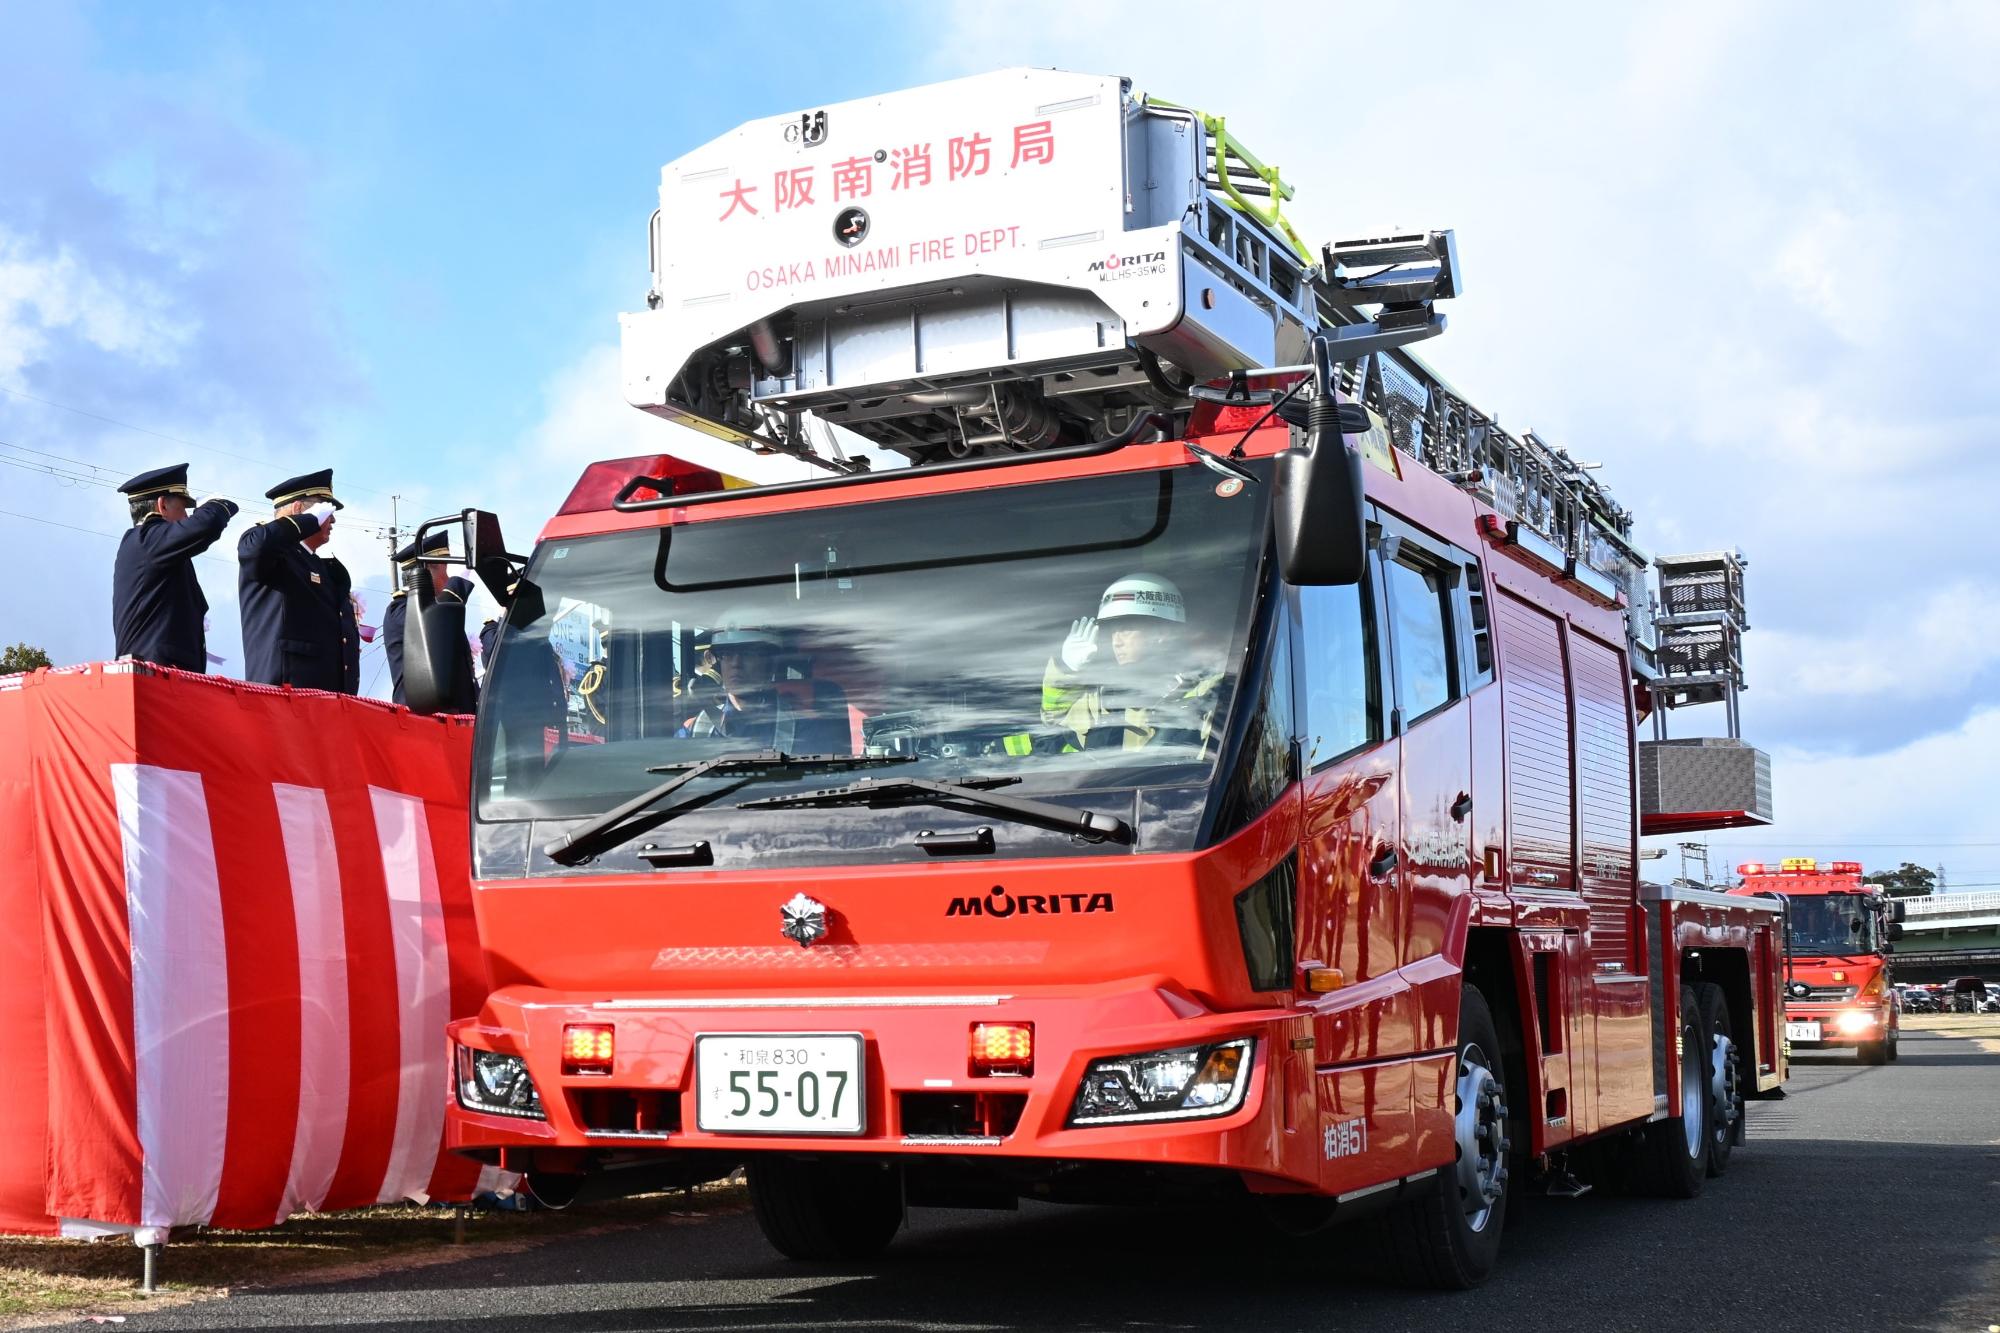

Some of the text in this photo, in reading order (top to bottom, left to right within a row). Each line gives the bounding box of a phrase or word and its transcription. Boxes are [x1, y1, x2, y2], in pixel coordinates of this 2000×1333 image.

[719, 120, 1055, 222] 大阪南消防局
[747, 261, 816, 291] OSAKA
[825, 246, 900, 279] MINAMI
[909, 236, 955, 265] FIRE
[1087, 251, 1165, 272] MORITA
[945, 885, 1114, 918] MORITA
[730, 1070, 848, 1118] 55-07
